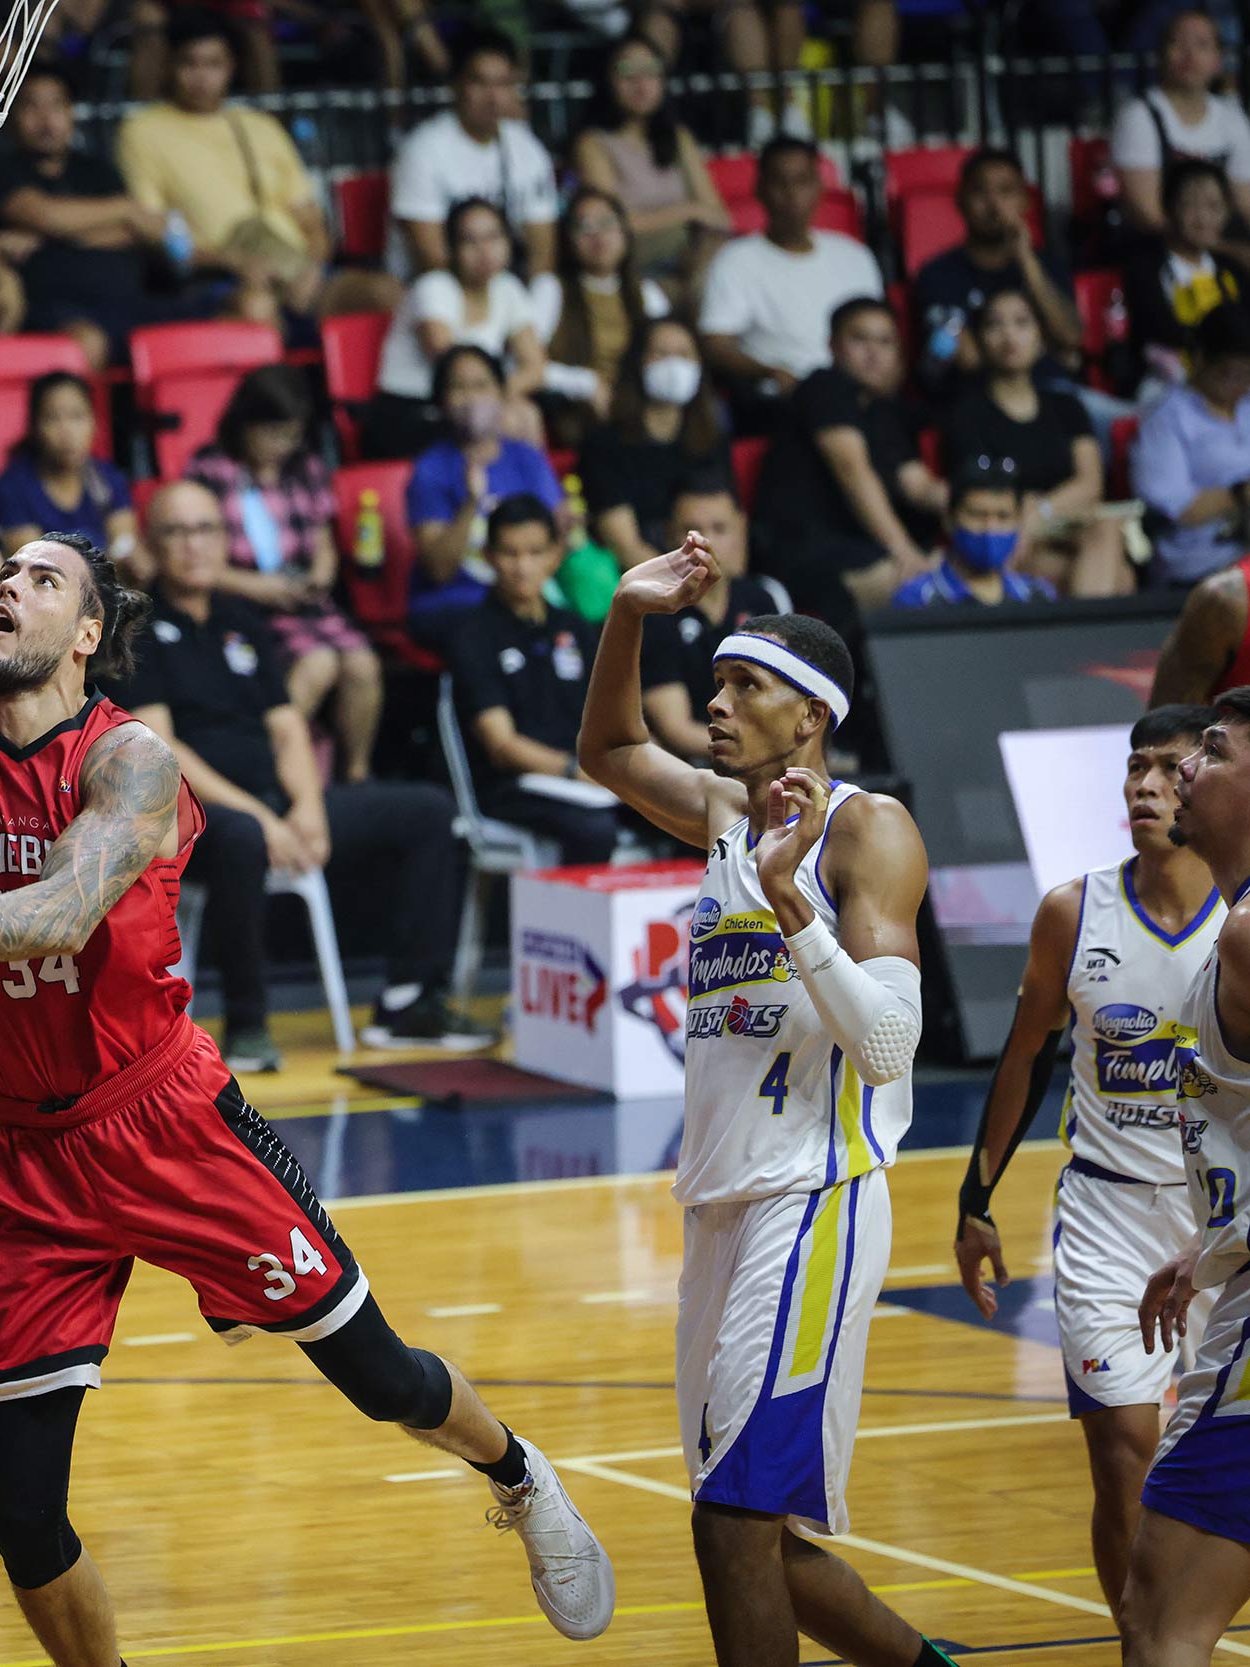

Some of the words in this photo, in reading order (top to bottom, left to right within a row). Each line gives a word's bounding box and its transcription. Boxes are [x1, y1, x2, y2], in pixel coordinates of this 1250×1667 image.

[724, 916, 764, 930] Chicken
[2, 955, 80, 999] 34
[758, 1050, 792, 1116] 4
[247, 1225, 328, 1301] 34
